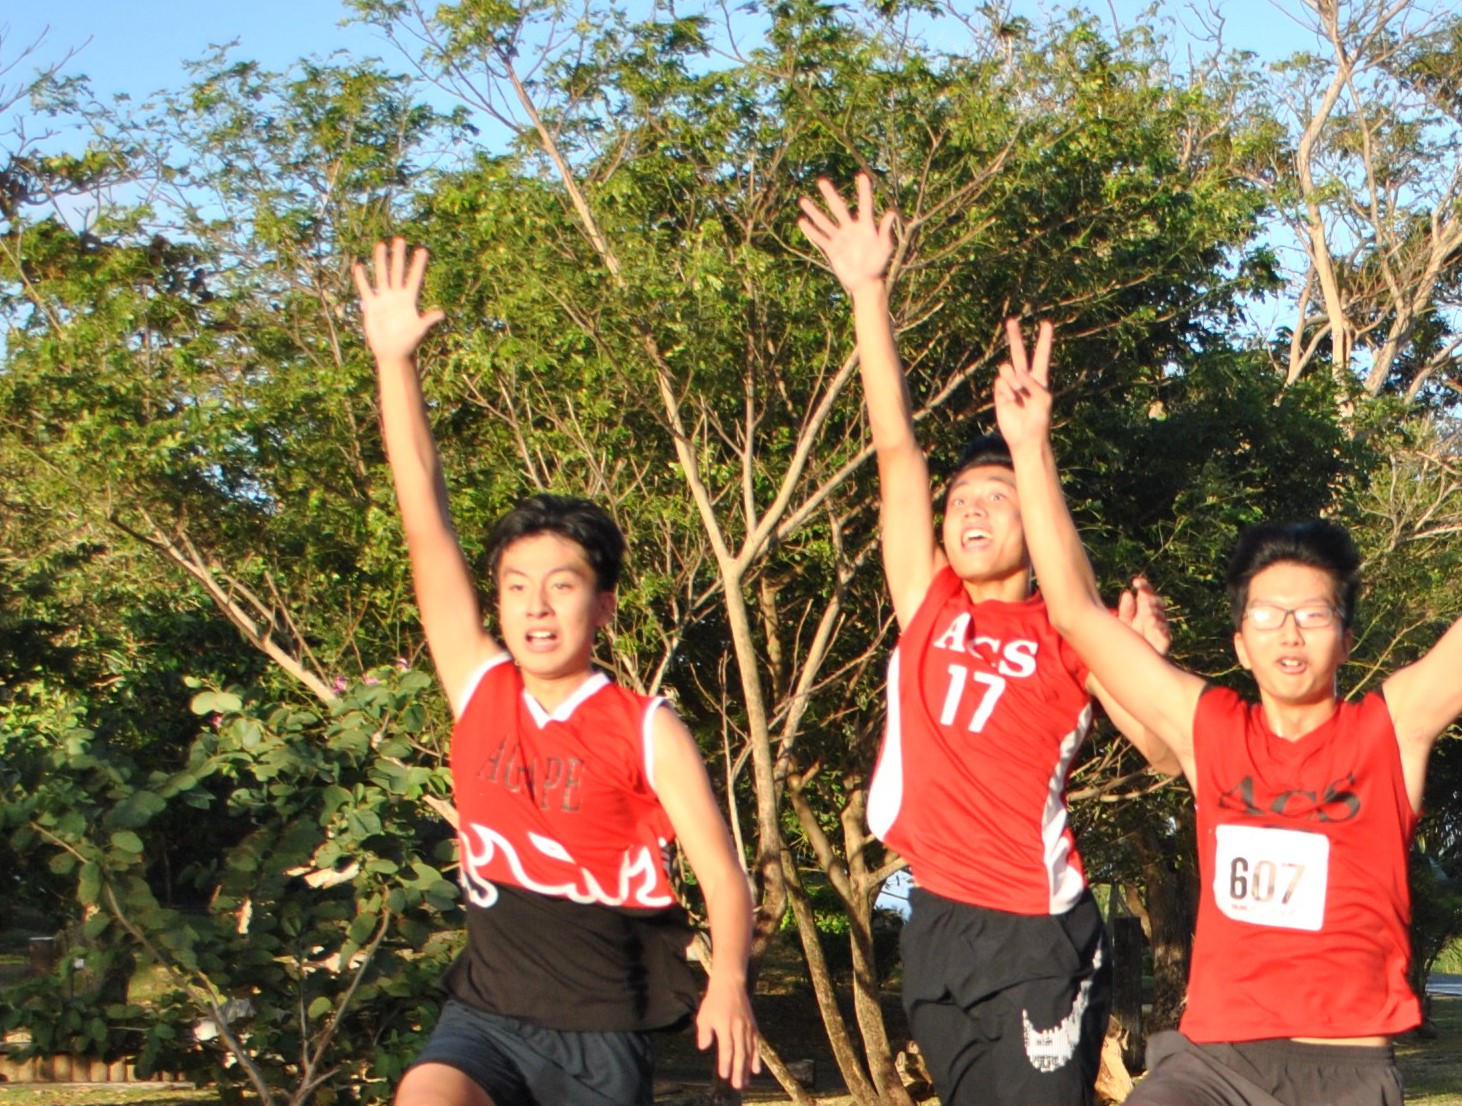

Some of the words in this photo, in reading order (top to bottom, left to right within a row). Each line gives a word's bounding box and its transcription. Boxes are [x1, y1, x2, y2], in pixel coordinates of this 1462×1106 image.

[933, 612, 1038, 678] ACS
[940, 664, 1006, 734] 17
[1217, 775, 1361, 822] ACS
[1229, 856, 1306, 905] 607
